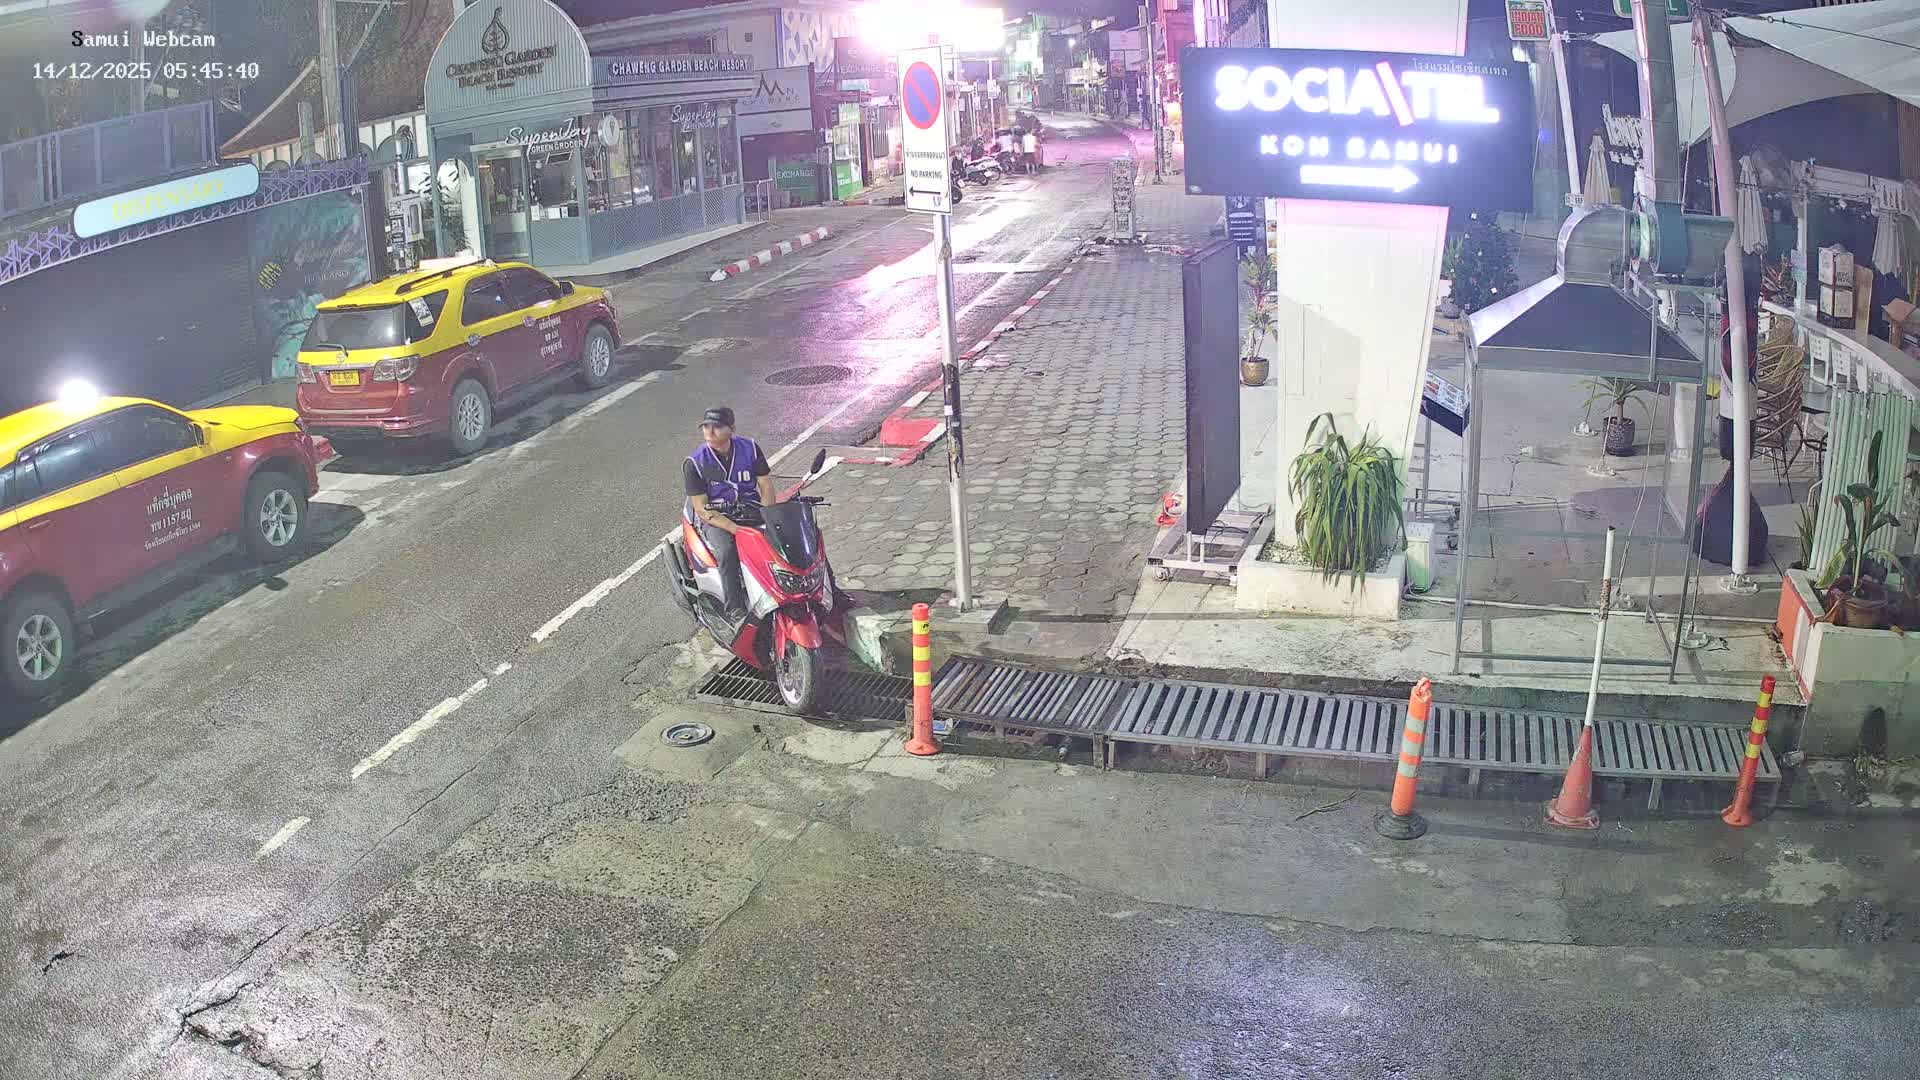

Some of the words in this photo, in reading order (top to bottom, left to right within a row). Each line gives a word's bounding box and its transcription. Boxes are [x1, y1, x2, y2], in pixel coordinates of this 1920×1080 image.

[1511, 10, 1544, 24] INDIAN
[1515, 23, 1544, 37] FOOD
[612, 60, 656, 75] CHAWENG
[660, 59, 692, 73] GARDEN
[695, 59, 718, 71] BEACH
[721, 59, 748, 71] RESORT
[1260, 134, 1330, 157] KOH
[1346, 136, 1459, 164] SAMUI
[776, 168, 816, 179] EXCHANGE
[910, 169, 919, 178] NO
[919, 170, 943, 180] PARKING
[113, 177, 225, 222] DISPENSARY
